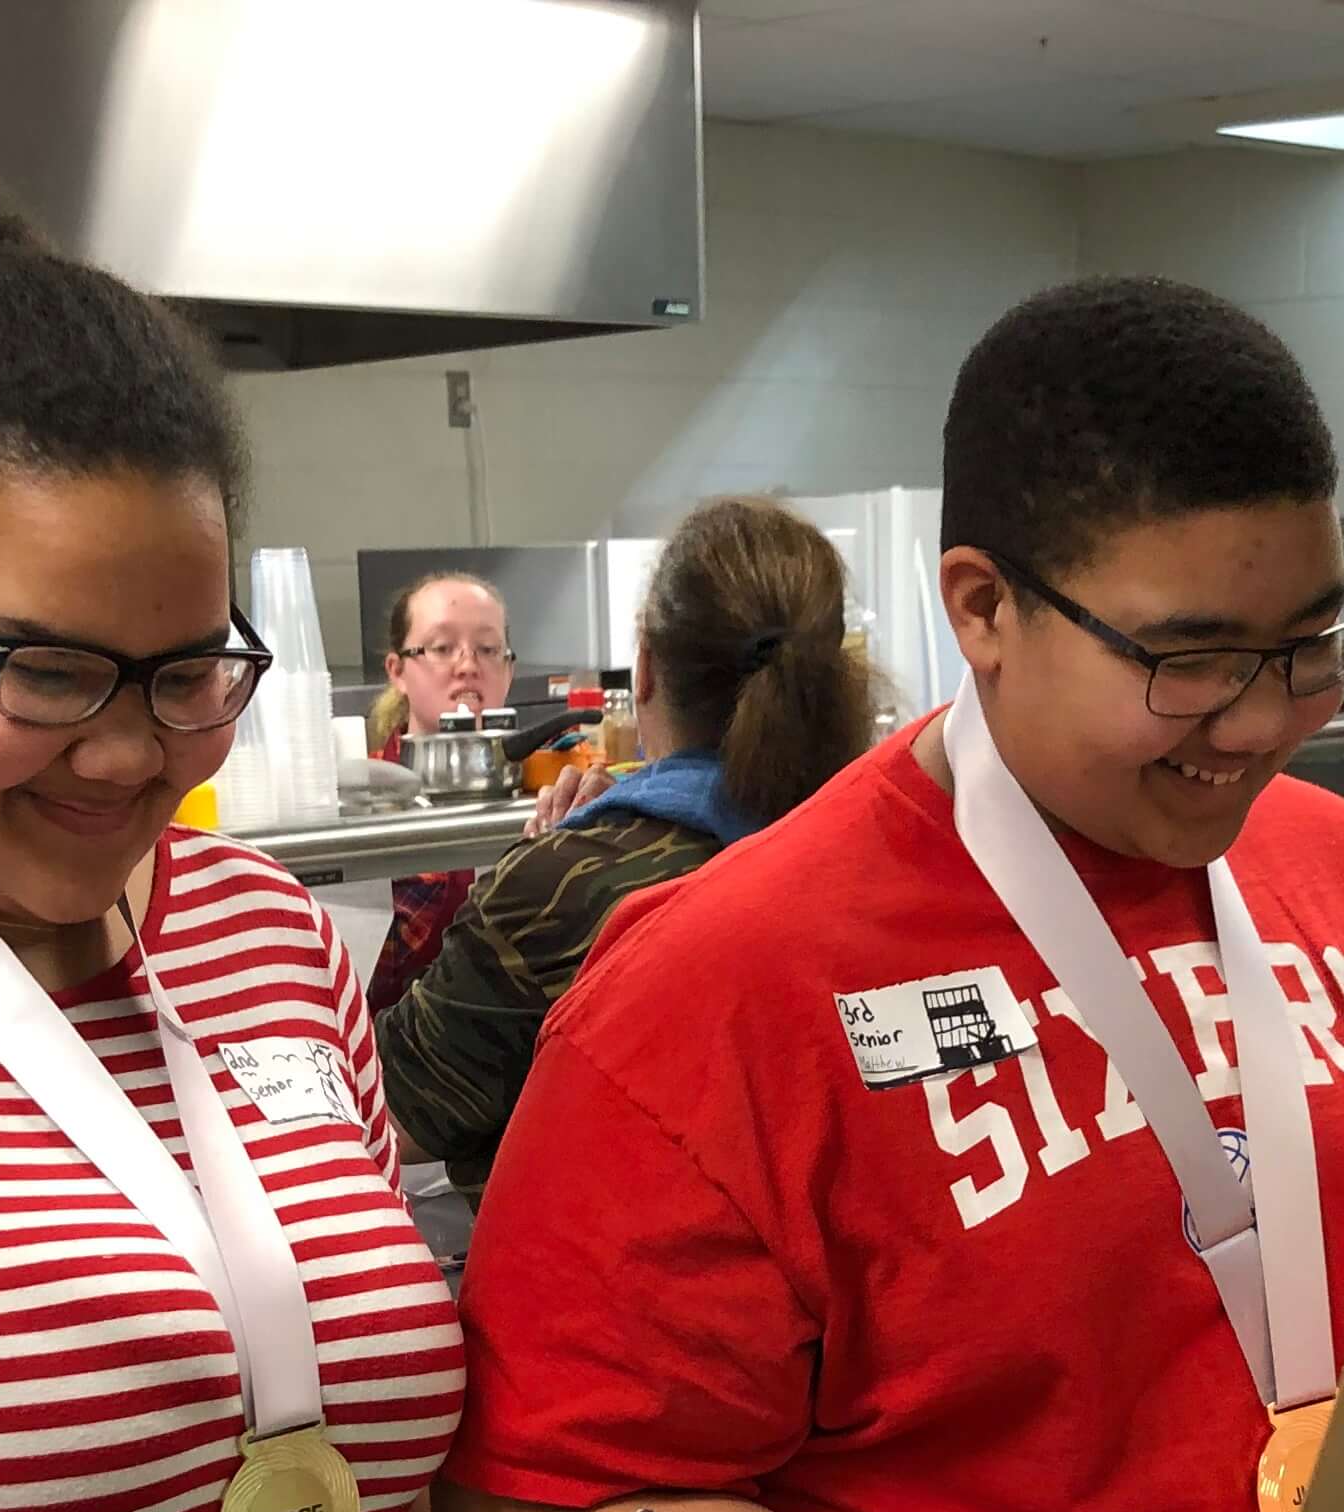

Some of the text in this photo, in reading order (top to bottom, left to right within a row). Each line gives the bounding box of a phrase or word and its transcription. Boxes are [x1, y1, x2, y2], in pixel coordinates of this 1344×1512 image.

[838, 998, 875, 1026] 3rd
[849, 1029, 904, 1049] senior
[222, 1045, 260, 1070] 2nd
